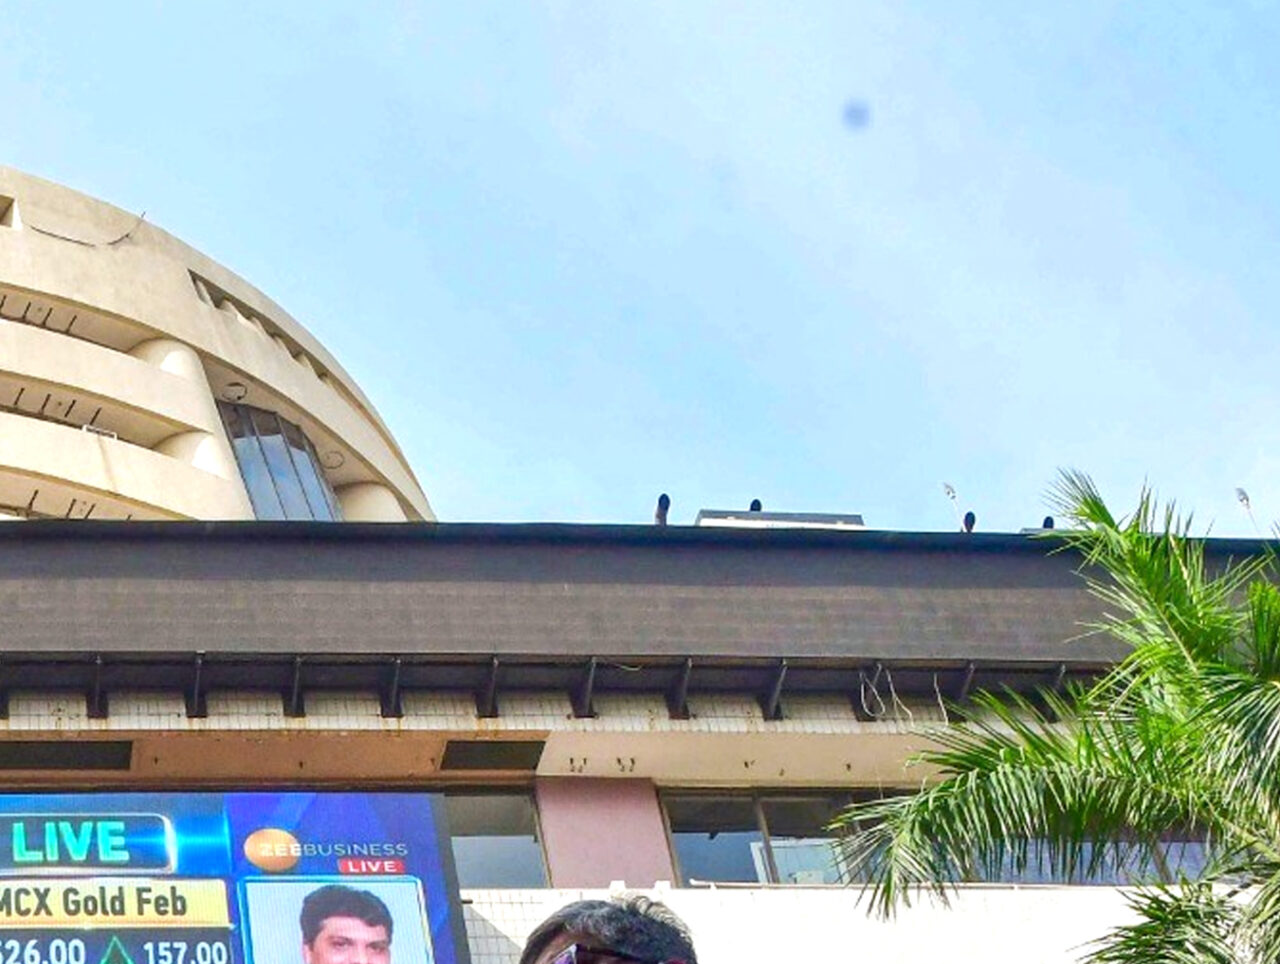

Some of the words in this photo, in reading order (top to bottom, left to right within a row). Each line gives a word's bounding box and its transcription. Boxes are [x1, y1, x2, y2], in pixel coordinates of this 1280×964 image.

[12, 821, 130, 863] LIVE
[347, 860, 396, 873] LIVE
[63, 886, 125, 915] Gold
[136, 886, 187, 916] Feb
